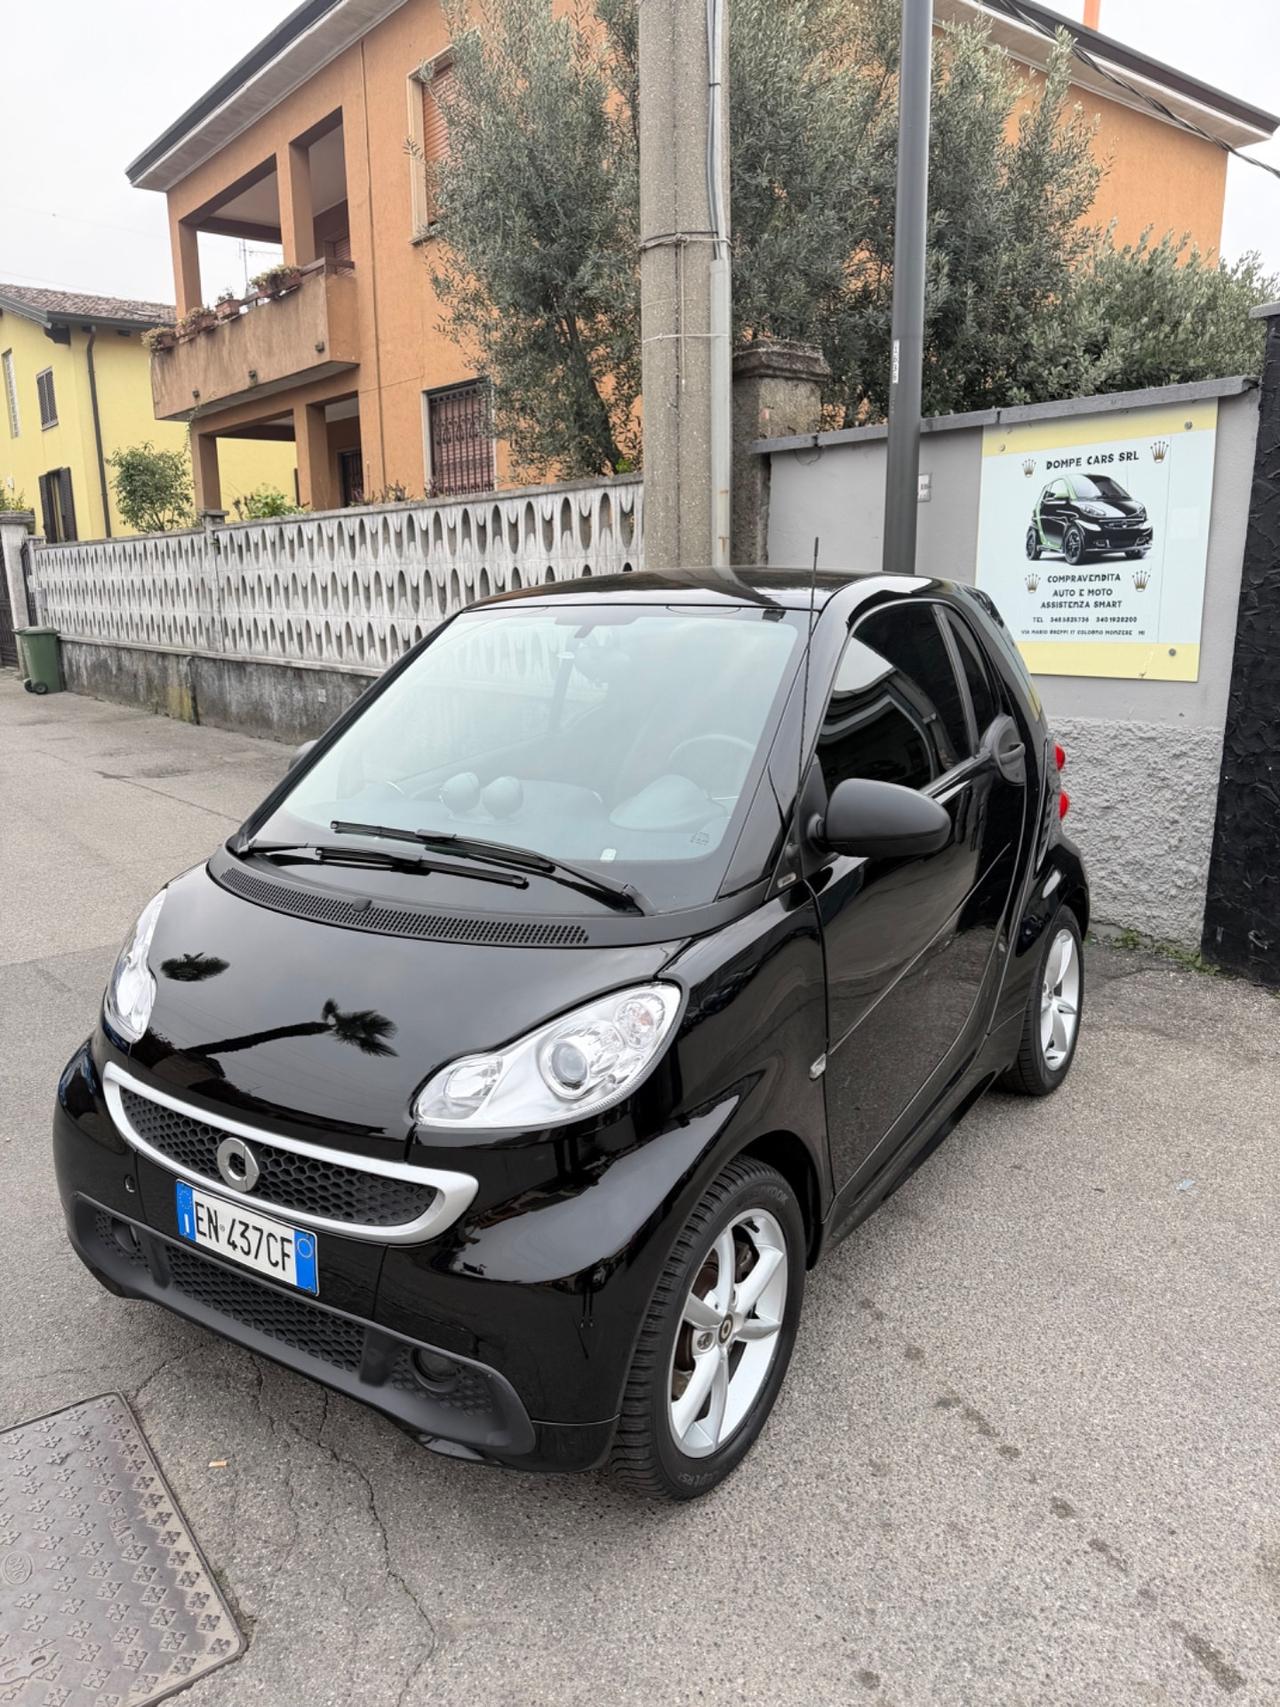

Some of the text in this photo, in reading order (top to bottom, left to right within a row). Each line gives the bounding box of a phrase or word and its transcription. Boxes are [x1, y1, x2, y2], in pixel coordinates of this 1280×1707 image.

[1046, 451, 1139, 470] DOMPE CARS SRL
[1047, 573, 1121, 583] COMPRAVENDITA
[1052, 588, 1113, 597] AUTO E MOTO
[1040, 600, 1122, 609] ASSISTENZA SMART
